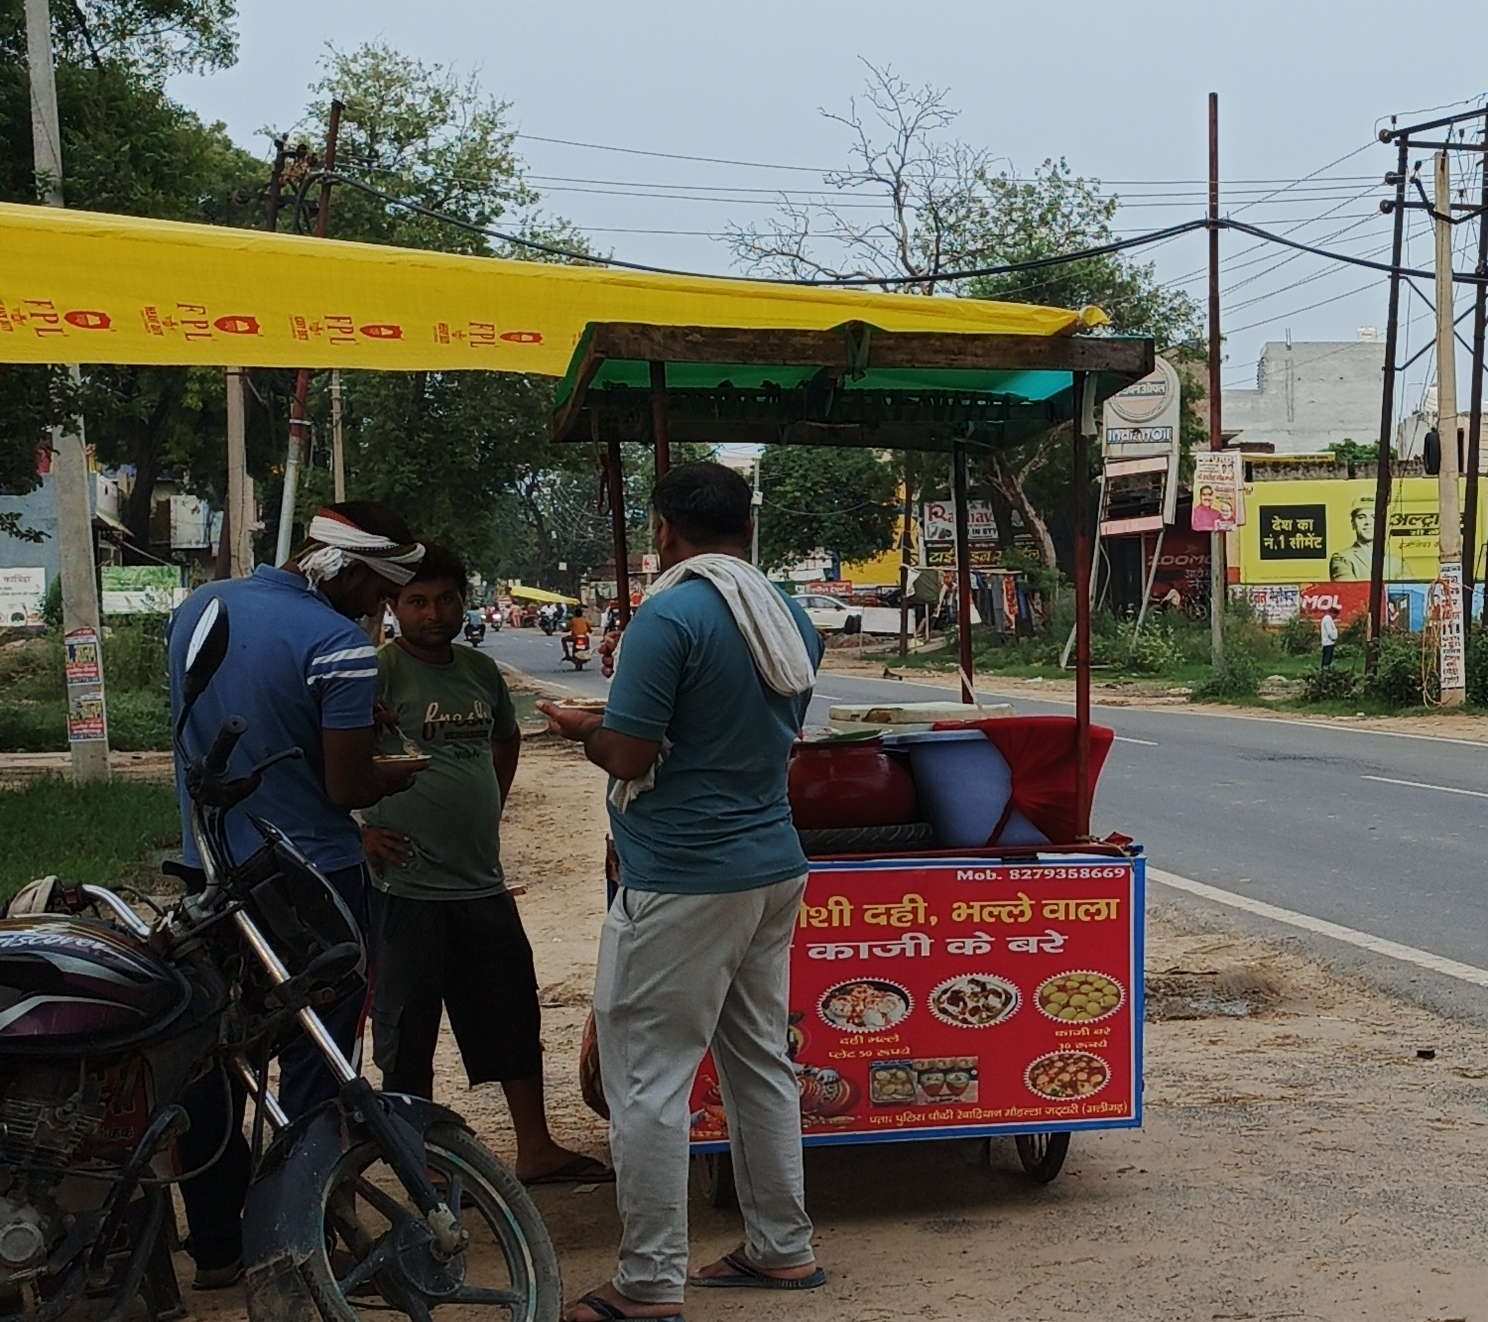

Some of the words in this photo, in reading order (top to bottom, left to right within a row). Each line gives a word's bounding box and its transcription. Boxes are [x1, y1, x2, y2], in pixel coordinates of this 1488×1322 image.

[176, 303, 213, 342] FPL
[324, 315, 356, 346] FPL
[469, 322, 496, 349] FPL
[1107, 427, 1171, 443] IndianOil
[1271, 516, 1293, 532] देश
[1296, 518, 1315, 531] का
[1289, 532, 1323, 550] सीमेंट
[1300, 595, 1343, 610] MOL
[956, 869, 1003, 881] Mob.
[863, 893, 938, 927] दही,
[952, 891, 1036, 923] भल्ले
[1041, 898, 1121, 922] वाला
[0, 934, 109, 951] iscover
[806, 932, 935, 961] काजी
[945, 931, 996, 956] के
[1006, 929, 1068, 955] बरे
[859, 1050, 873, 1058] 50
